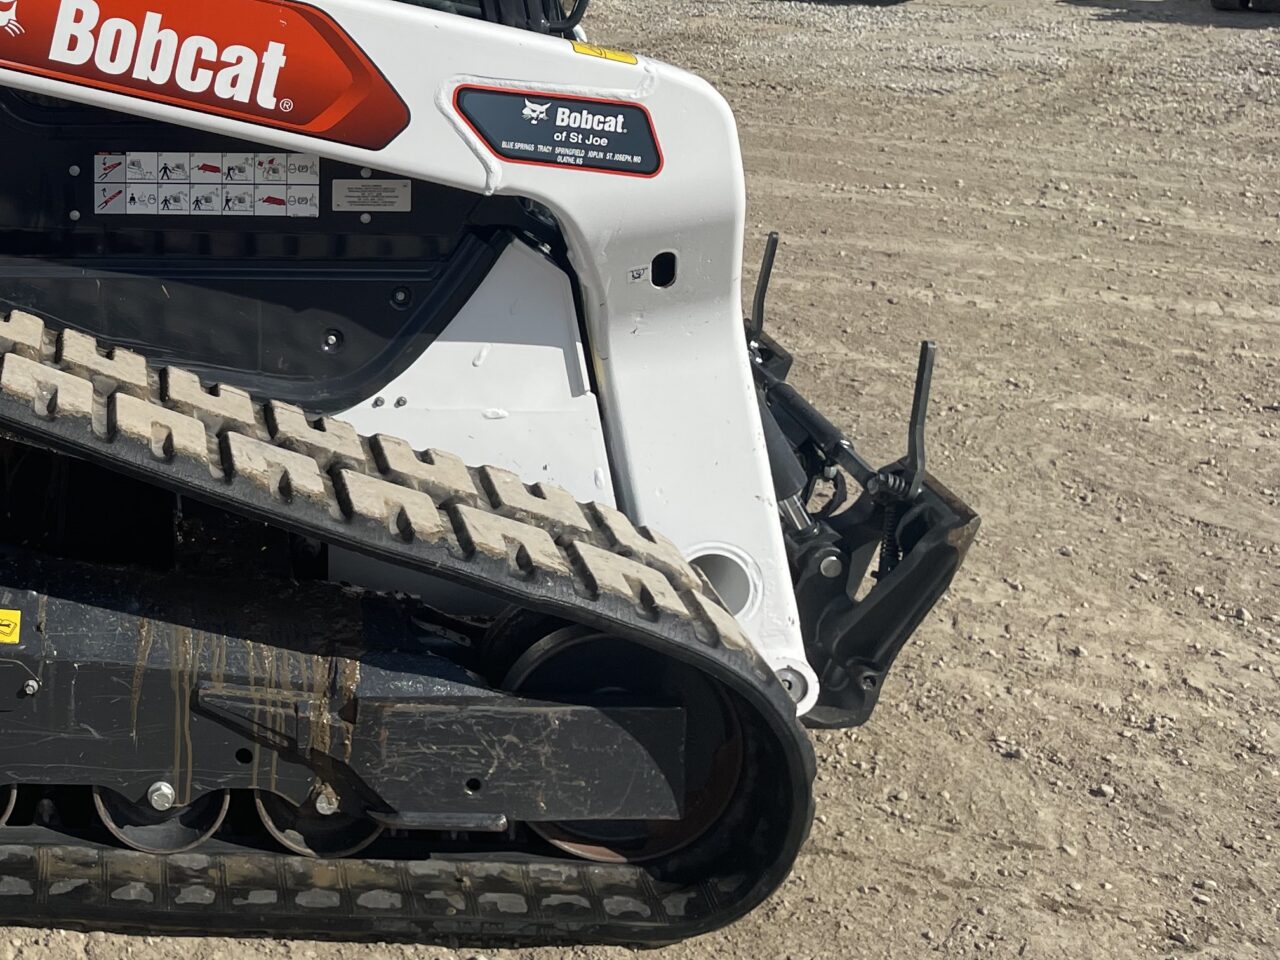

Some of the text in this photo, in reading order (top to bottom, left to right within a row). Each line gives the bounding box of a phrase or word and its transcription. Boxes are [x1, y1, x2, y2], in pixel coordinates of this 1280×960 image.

[555, 107, 625, 133] Bobcat
[554, 131, 609, 146] of St Joe
[501, 141, 514, 149] BLUE
[514, 142, 535, 151] SPRINGS
[537, 144, 553, 153] TRACY
[554, 146, 585, 157] SPRINGFIELD
[587, 150, 605, 159] JOPLIN
